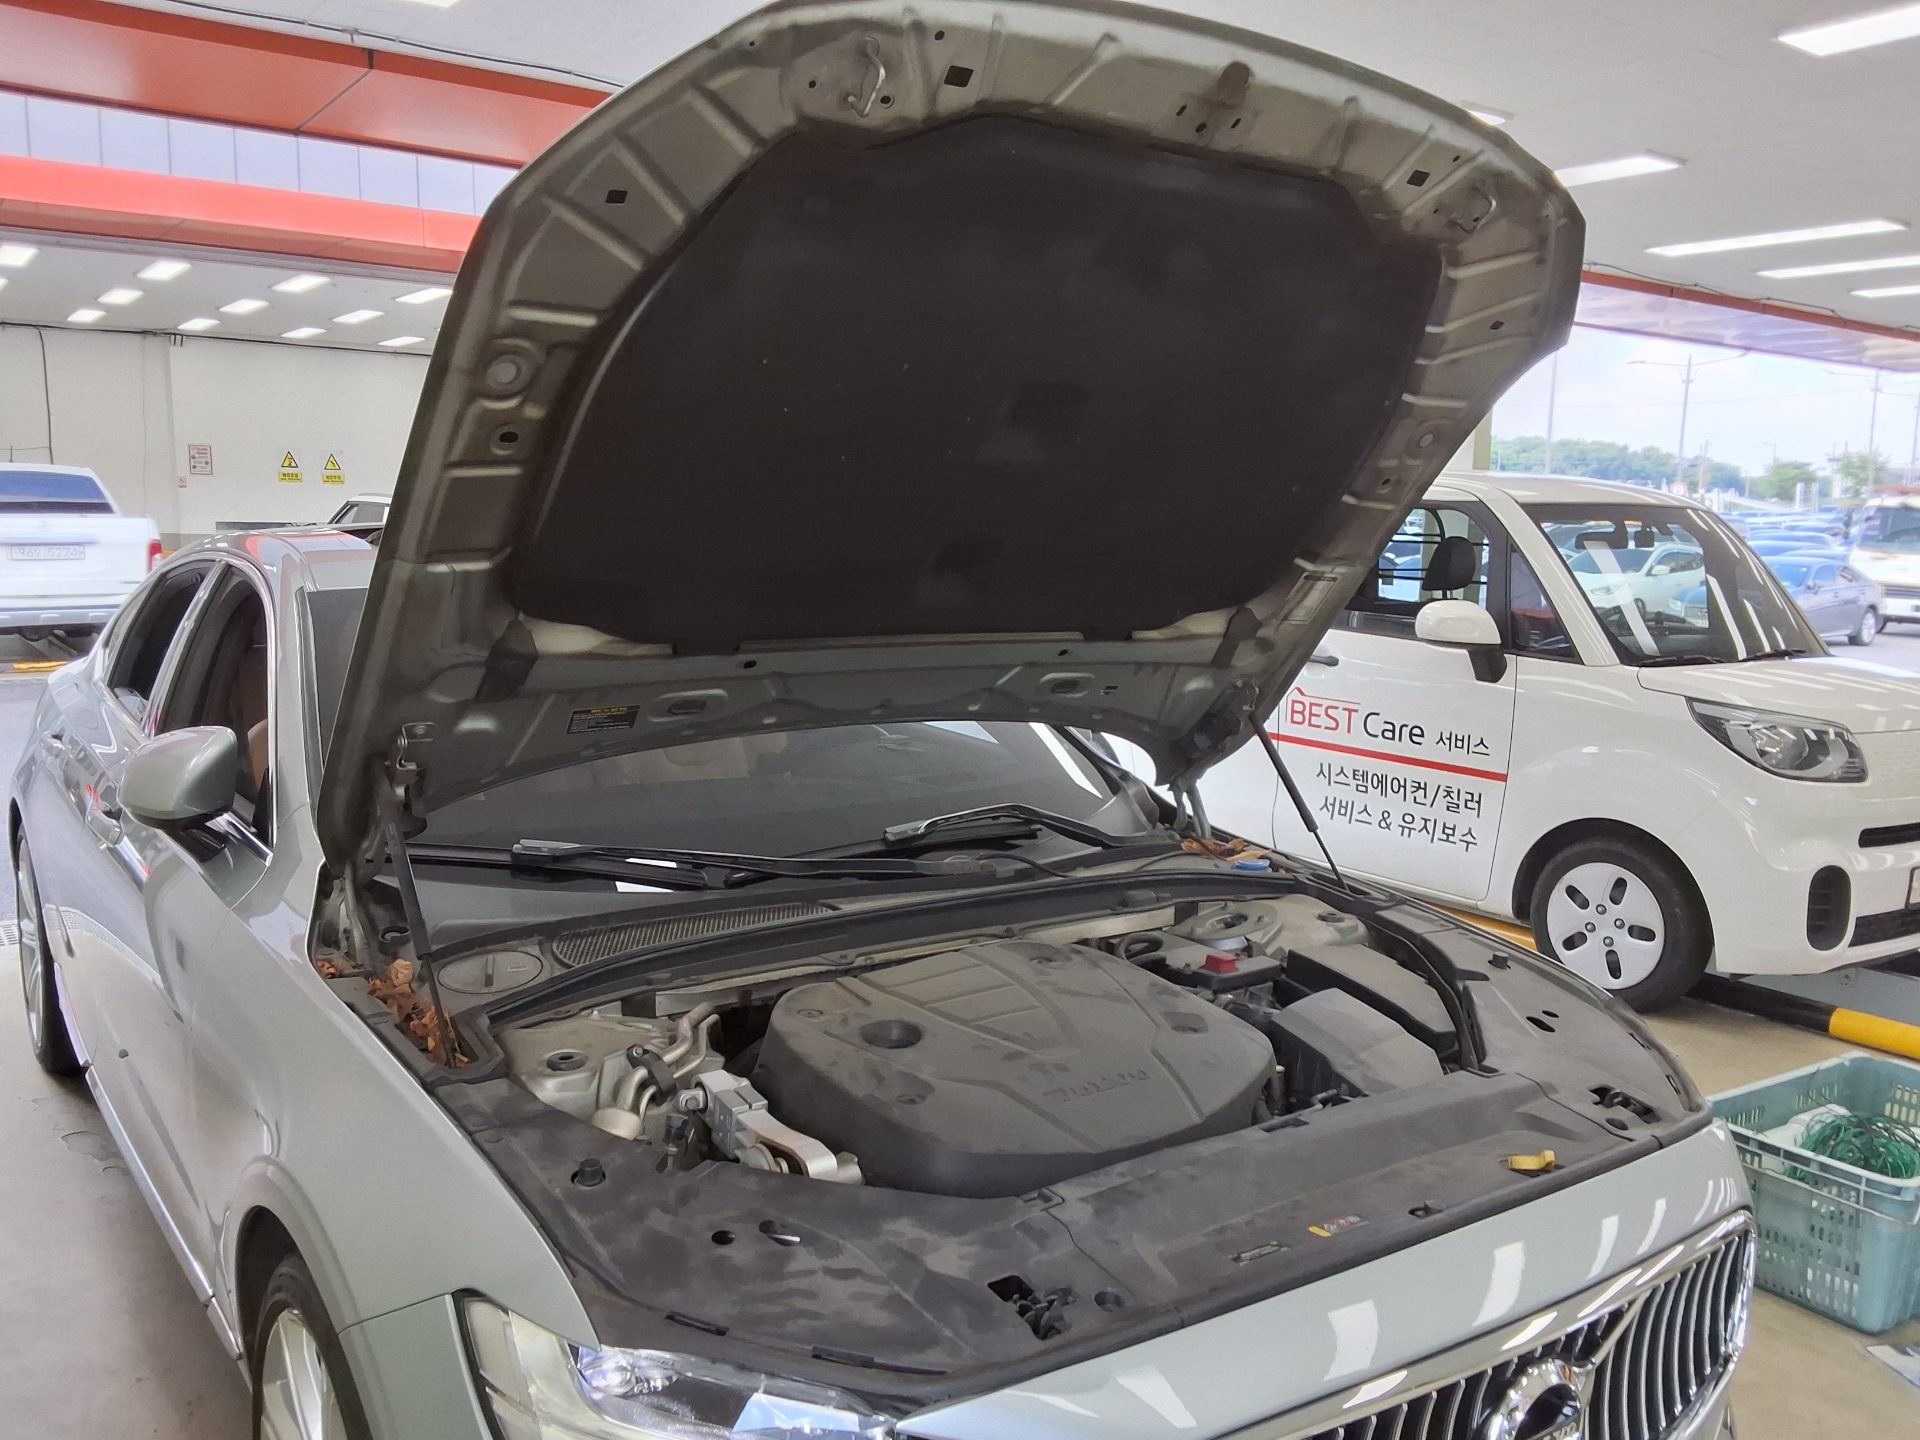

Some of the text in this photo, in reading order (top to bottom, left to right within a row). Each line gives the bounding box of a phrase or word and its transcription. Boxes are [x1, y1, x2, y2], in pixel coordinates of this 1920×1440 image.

[1290, 699, 1491, 757] BEST Care 서비스
[1316, 762, 1482, 818] 시스템에어컨/칠러
[1319, 796, 1478, 852] 서비스 & 유지보수
